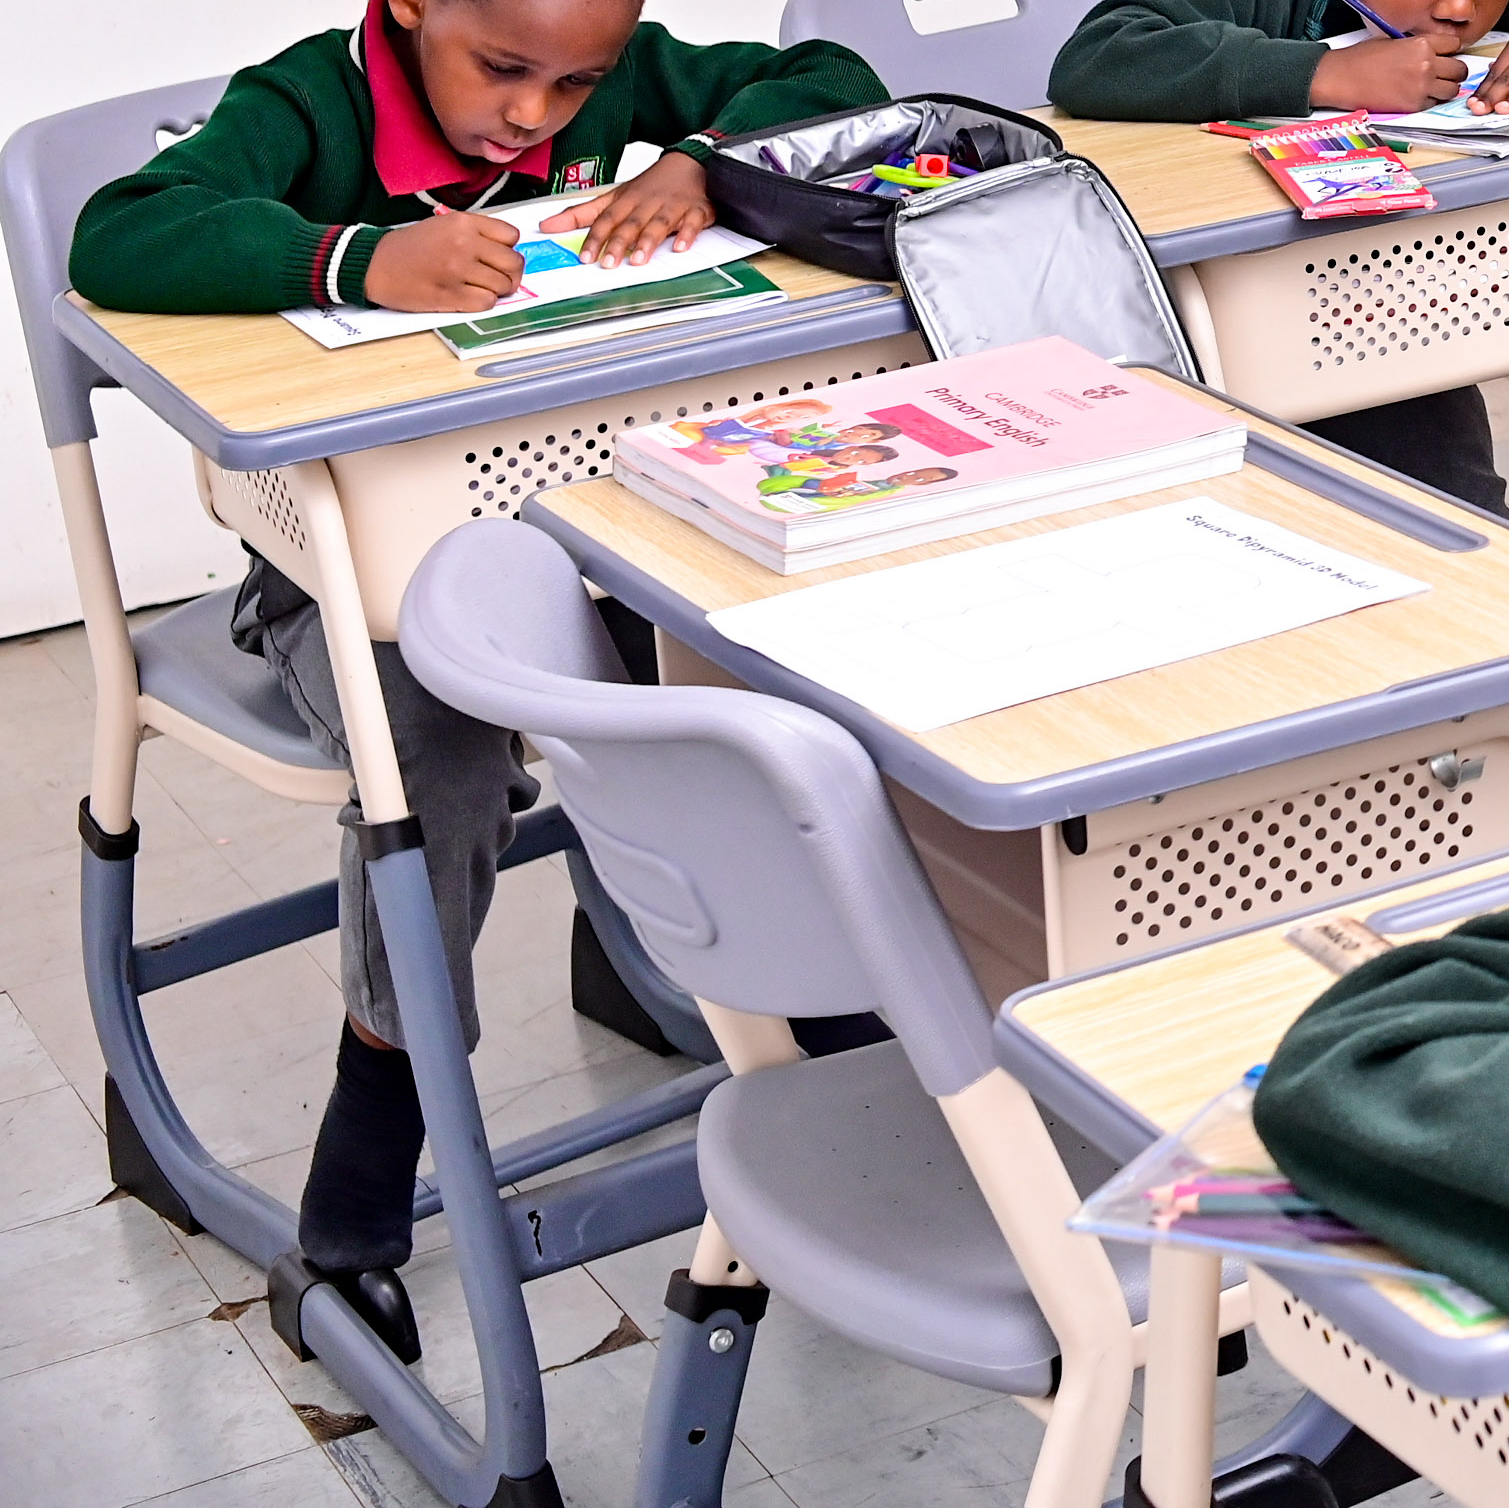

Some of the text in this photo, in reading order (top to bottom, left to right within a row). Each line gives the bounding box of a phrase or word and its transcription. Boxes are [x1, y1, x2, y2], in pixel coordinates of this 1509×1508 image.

[568, 167, 577, 180] S
[925, 387, 992, 421] Primary
[984, 418, 1049, 448] English
[984, 392, 1062, 428] CAMBRIDGE
[1186, 515, 1237, 538] Square
[1330, 572, 1379, 591] Model
